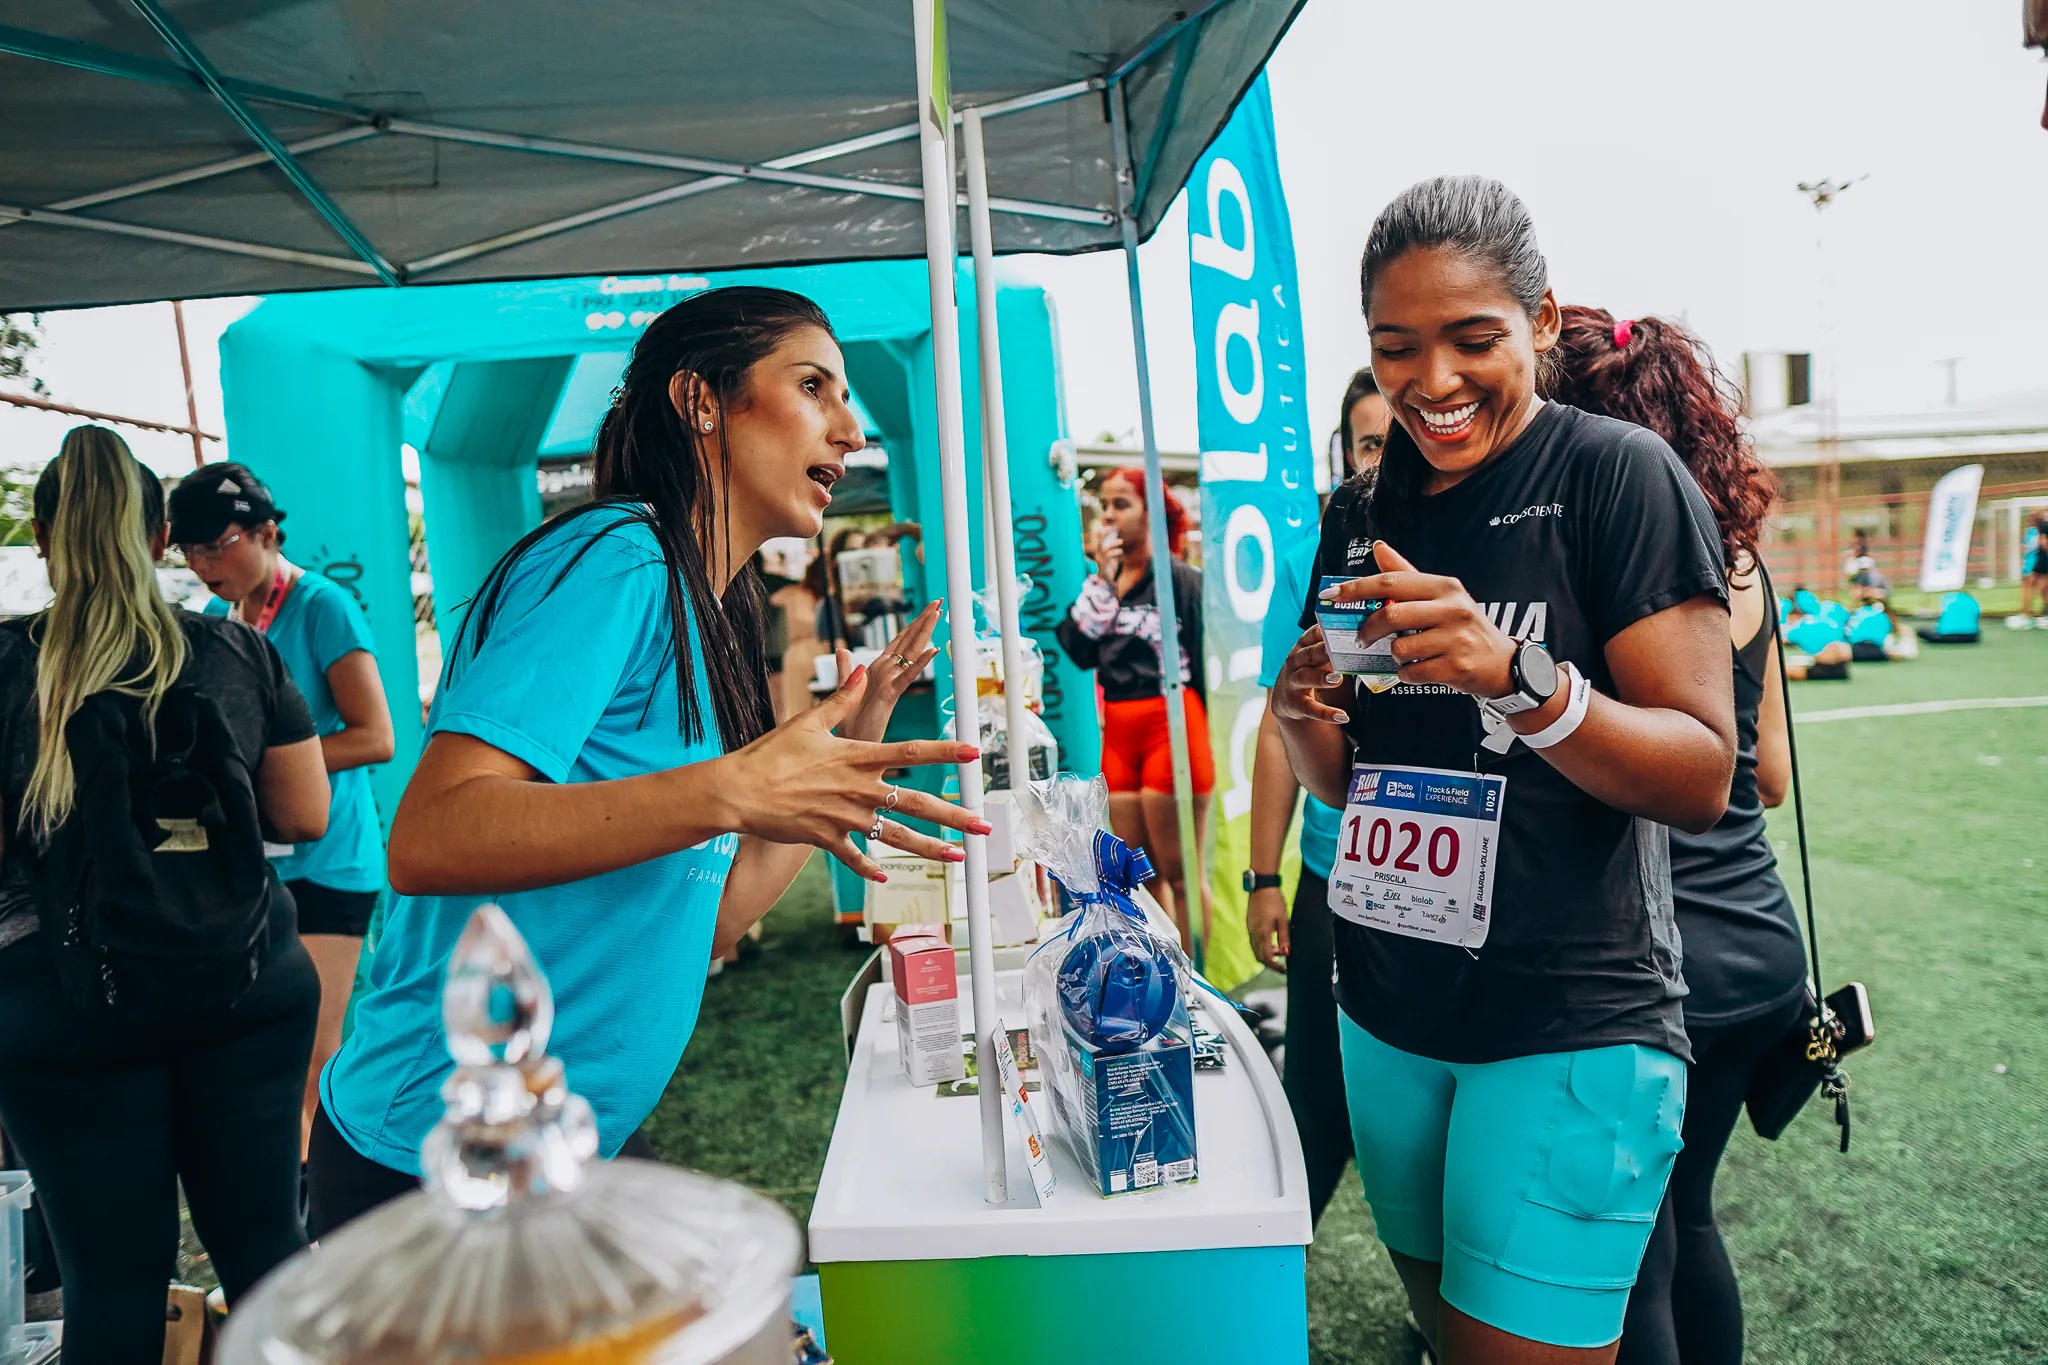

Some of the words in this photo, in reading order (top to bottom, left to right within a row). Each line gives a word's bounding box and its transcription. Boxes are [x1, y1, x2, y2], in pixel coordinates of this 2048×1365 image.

[1357, 772, 1381, 792] RUN
[1398, 783, 1414, 791] Porto
[1397, 790, 1415, 799] Saúde
[1425, 793, 1468, 805] EXPERIENCE
[1485, 790, 1497, 812] 1020
[1344, 815, 1460, 877] 1020
[1478, 836, 1490, 902] GUARDA-VOLUME
[1374, 872, 1407, 885] PRISCILA
[1411, 895, 1434, 905] biolab
